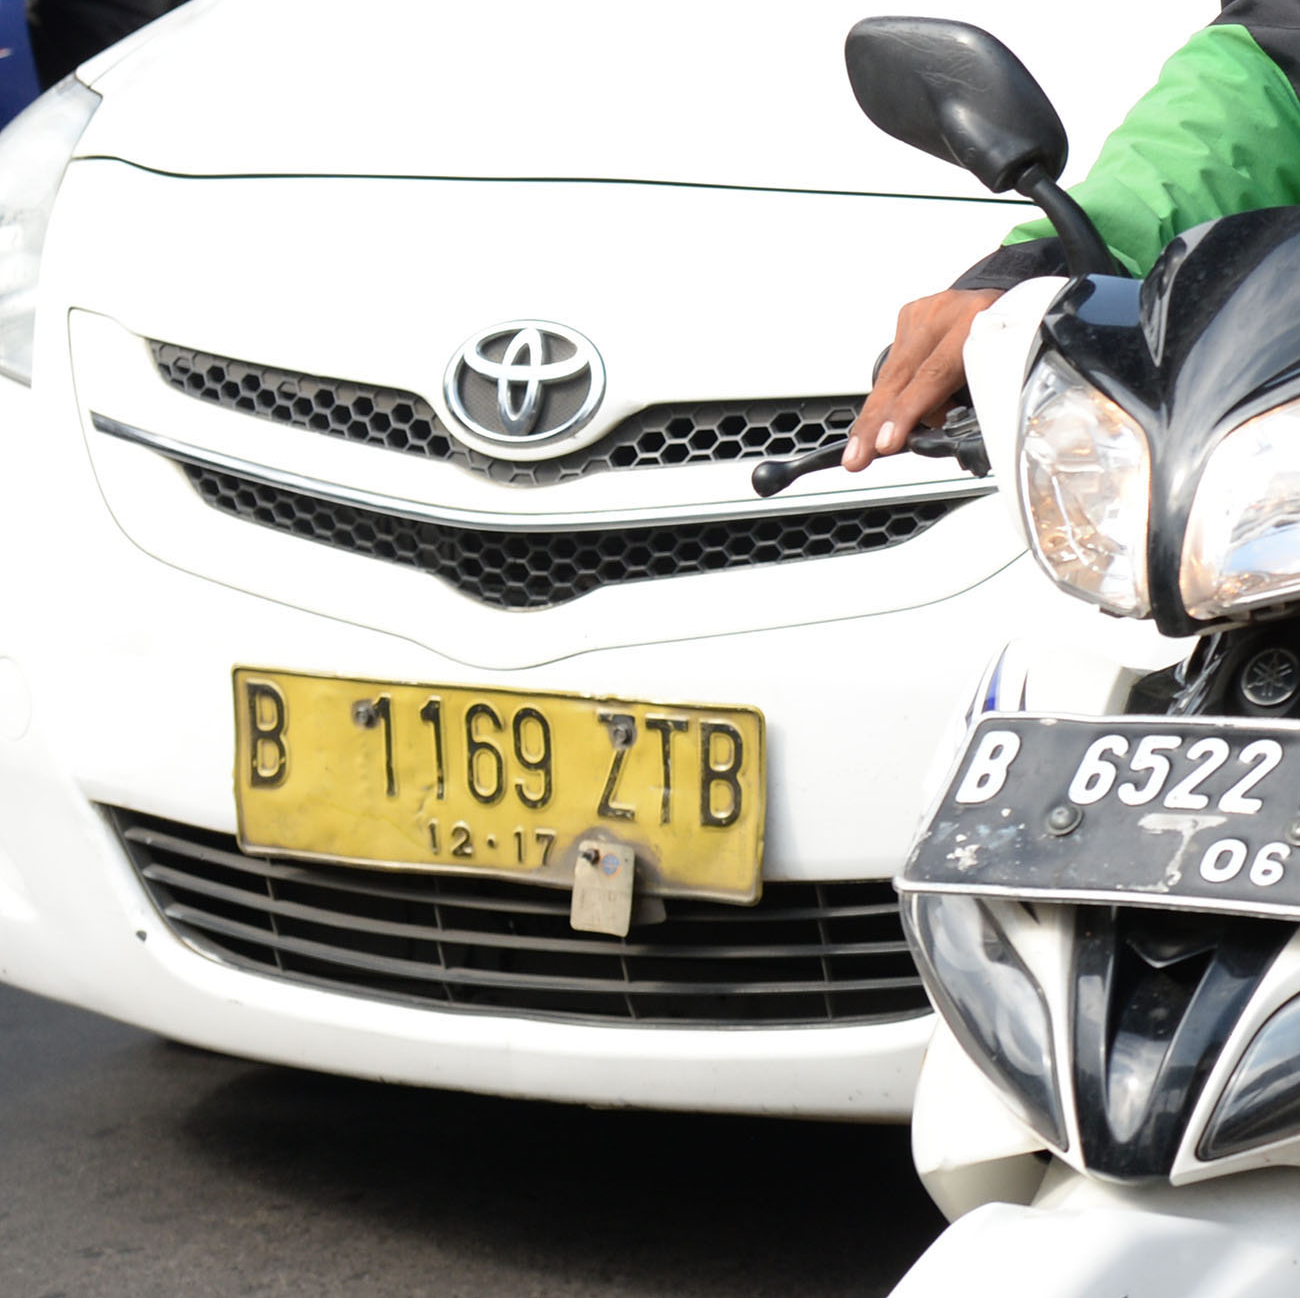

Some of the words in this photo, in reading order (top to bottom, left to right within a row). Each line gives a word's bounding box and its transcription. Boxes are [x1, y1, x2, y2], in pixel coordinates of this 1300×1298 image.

[246, 678, 290, 791] B
[373, 694, 556, 811] 1169
[597, 710, 744, 830] ZTB
[954, 729, 1022, 805] B
[1067, 733, 1285, 816] 6522
